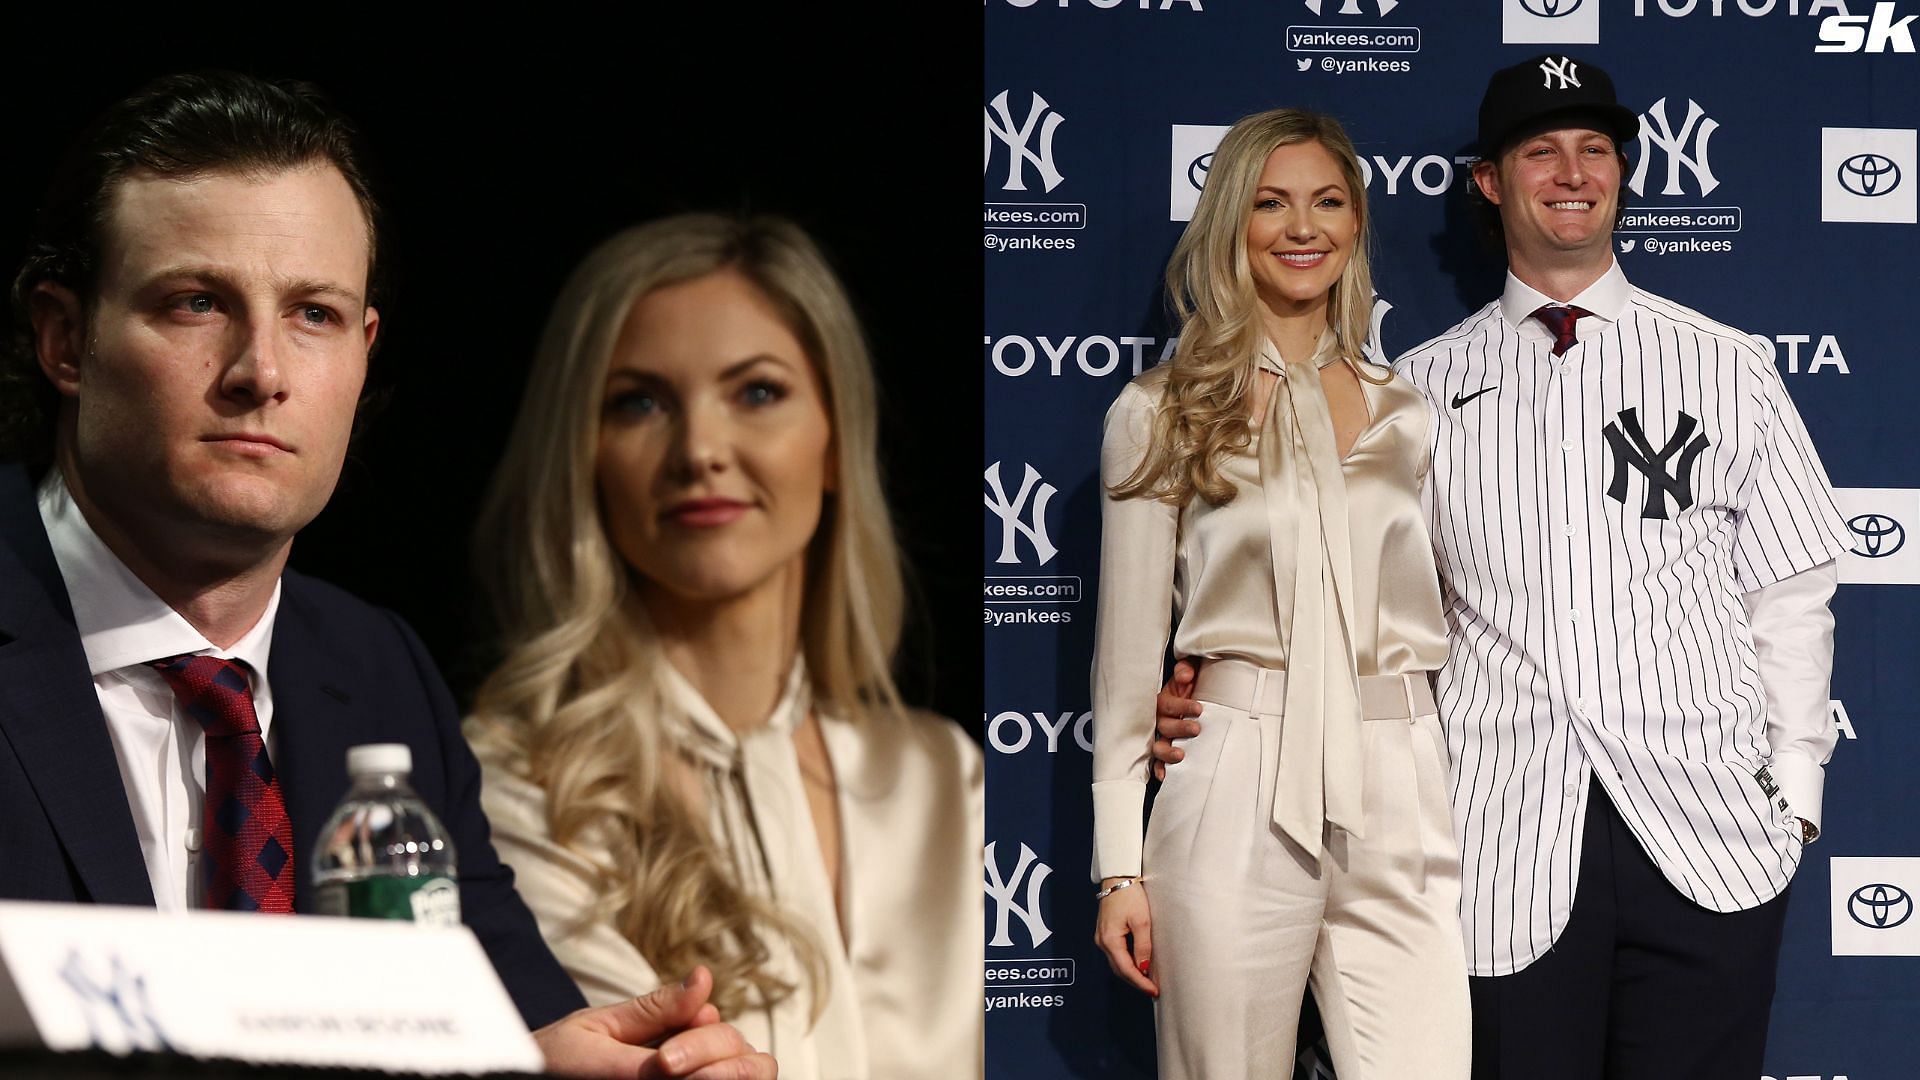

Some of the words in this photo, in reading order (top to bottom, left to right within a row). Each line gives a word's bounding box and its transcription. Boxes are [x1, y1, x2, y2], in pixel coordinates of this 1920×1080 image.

[1293, 31, 1415, 48] yankees.com
[1321, 57, 1411, 73] @yankees
[1539, 56, 1581, 90] NY
[1628, 97, 1720, 198] NY
[984, 234, 1076, 252] @yankees
[1644, 237, 1732, 255] @yankees
[1602, 407, 1710, 520] NY
